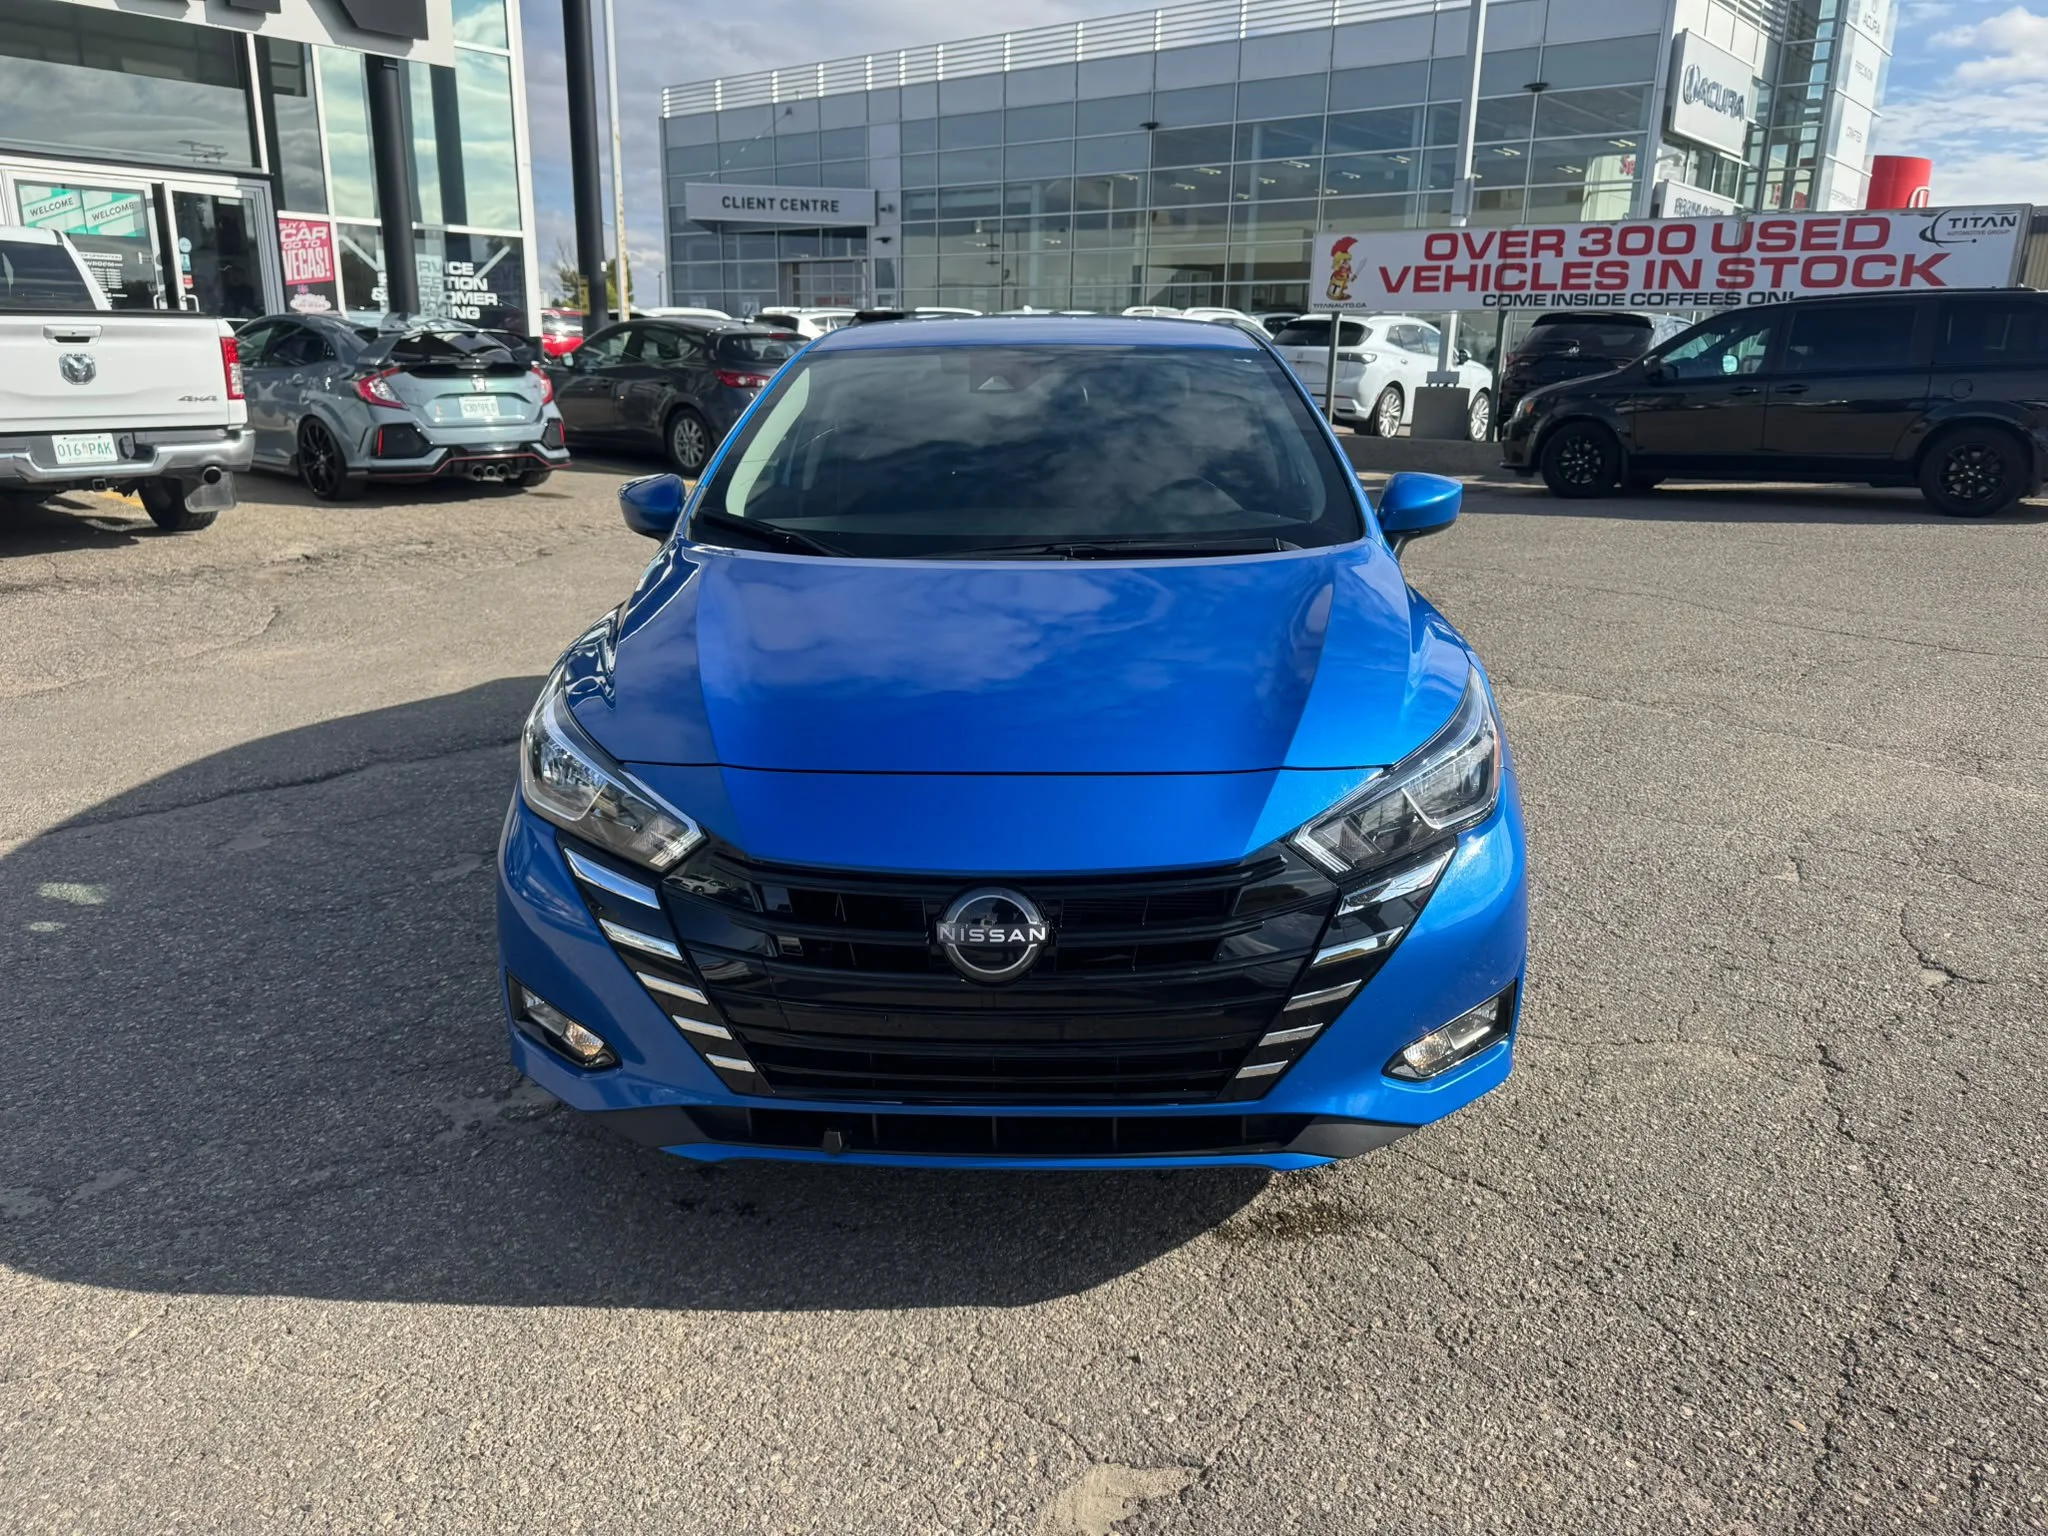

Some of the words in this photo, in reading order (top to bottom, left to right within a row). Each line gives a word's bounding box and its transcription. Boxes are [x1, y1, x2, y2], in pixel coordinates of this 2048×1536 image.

[1696, 77, 1744, 122] ACURA
[29, 197, 74, 217] WELCOME
[91, 202, 135, 221] WELCOME
[722, 195, 776, 211] CLIENT
[780, 198, 839, 213] CENTRE
[299, 220, 307, 228] A
[1949, 215, 2017, 228] TITAN
[280, 226, 328, 242] CAR
[1424, 228, 1566, 262] OVER
[1578, 224, 1697, 258] 300
[1711, 216, 1891, 254] USED
[283, 241, 302, 250] GO
[303, 239, 320, 248] TO
[282, 247, 331, 281] VEGAS!
[1378, 259, 1630, 294] VEHICLES
[1643, 258, 1703, 291] IN
[1715, 252, 1952, 289] STOCK
[1482, 293, 1547, 307] COME
[1551, 292, 1627, 307] INSIDE
[1630, 292, 1742, 307] COFFEES
[56, 443, 81, 457] 016
[89, 441, 113, 455] PAK
[939, 926, 1046, 943] NISSAN
